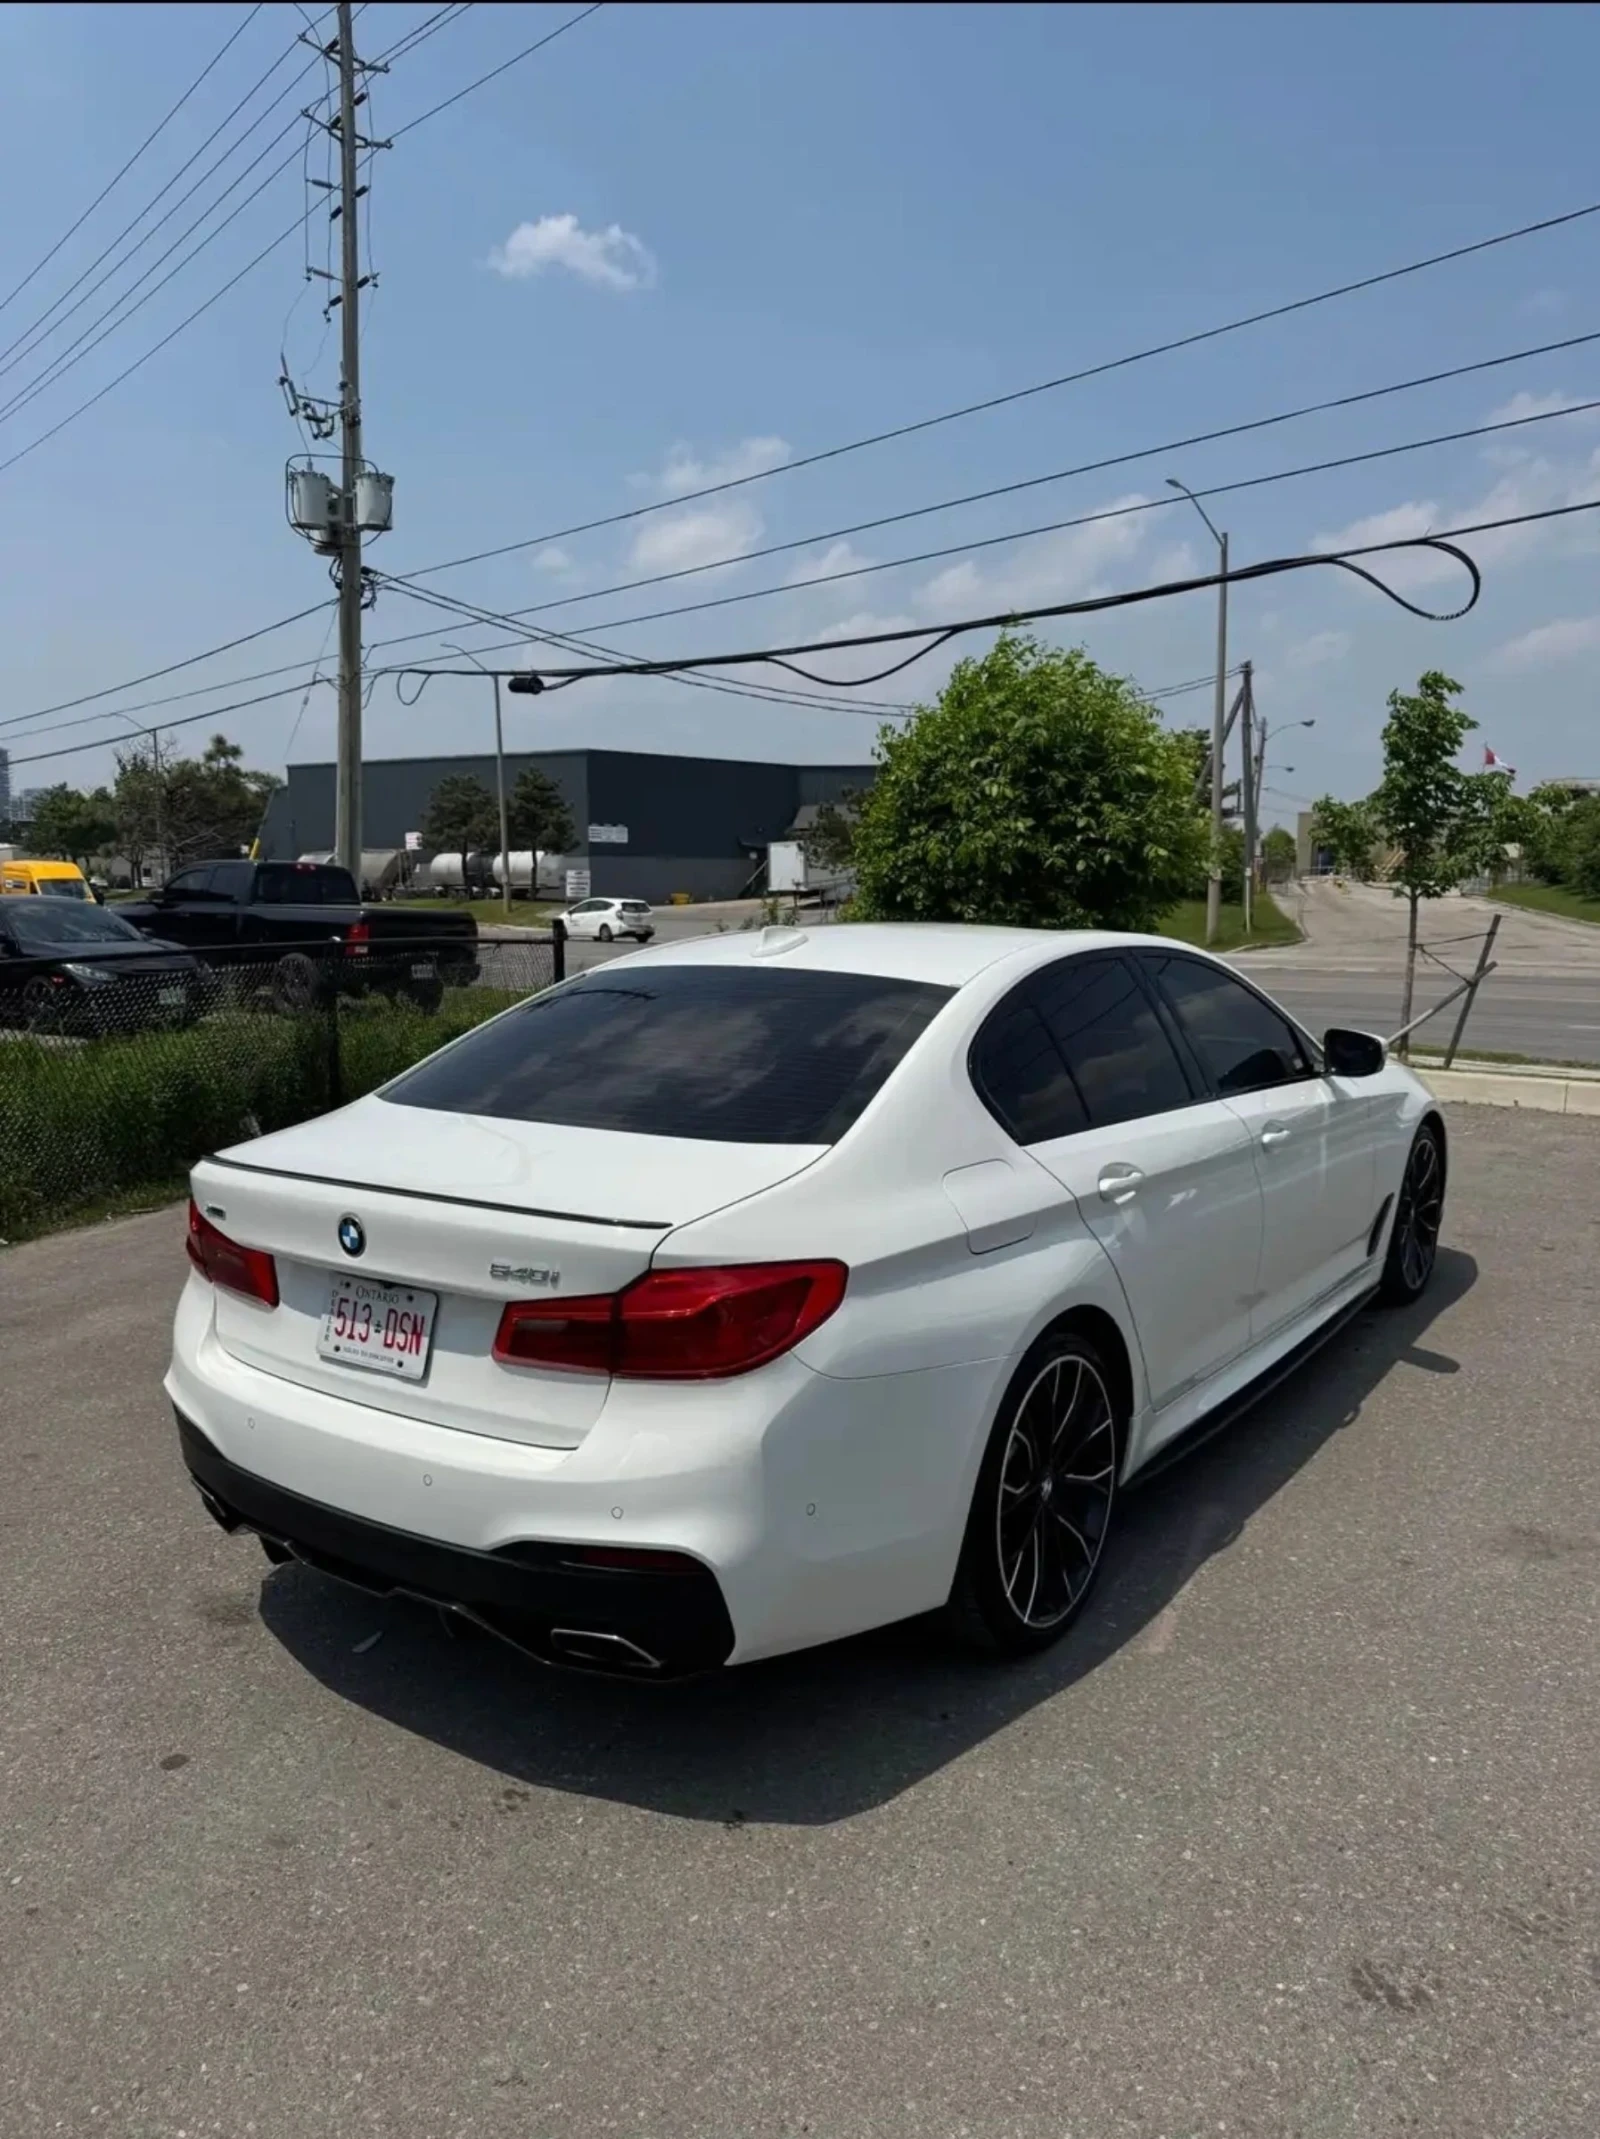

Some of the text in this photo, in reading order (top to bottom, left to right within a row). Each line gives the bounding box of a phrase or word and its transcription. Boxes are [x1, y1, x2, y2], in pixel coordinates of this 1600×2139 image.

[355, 1285, 400, 1304] ONTARIO
[334, 1297, 372, 1343] 513
[383, 1308, 425, 1356] DSN
